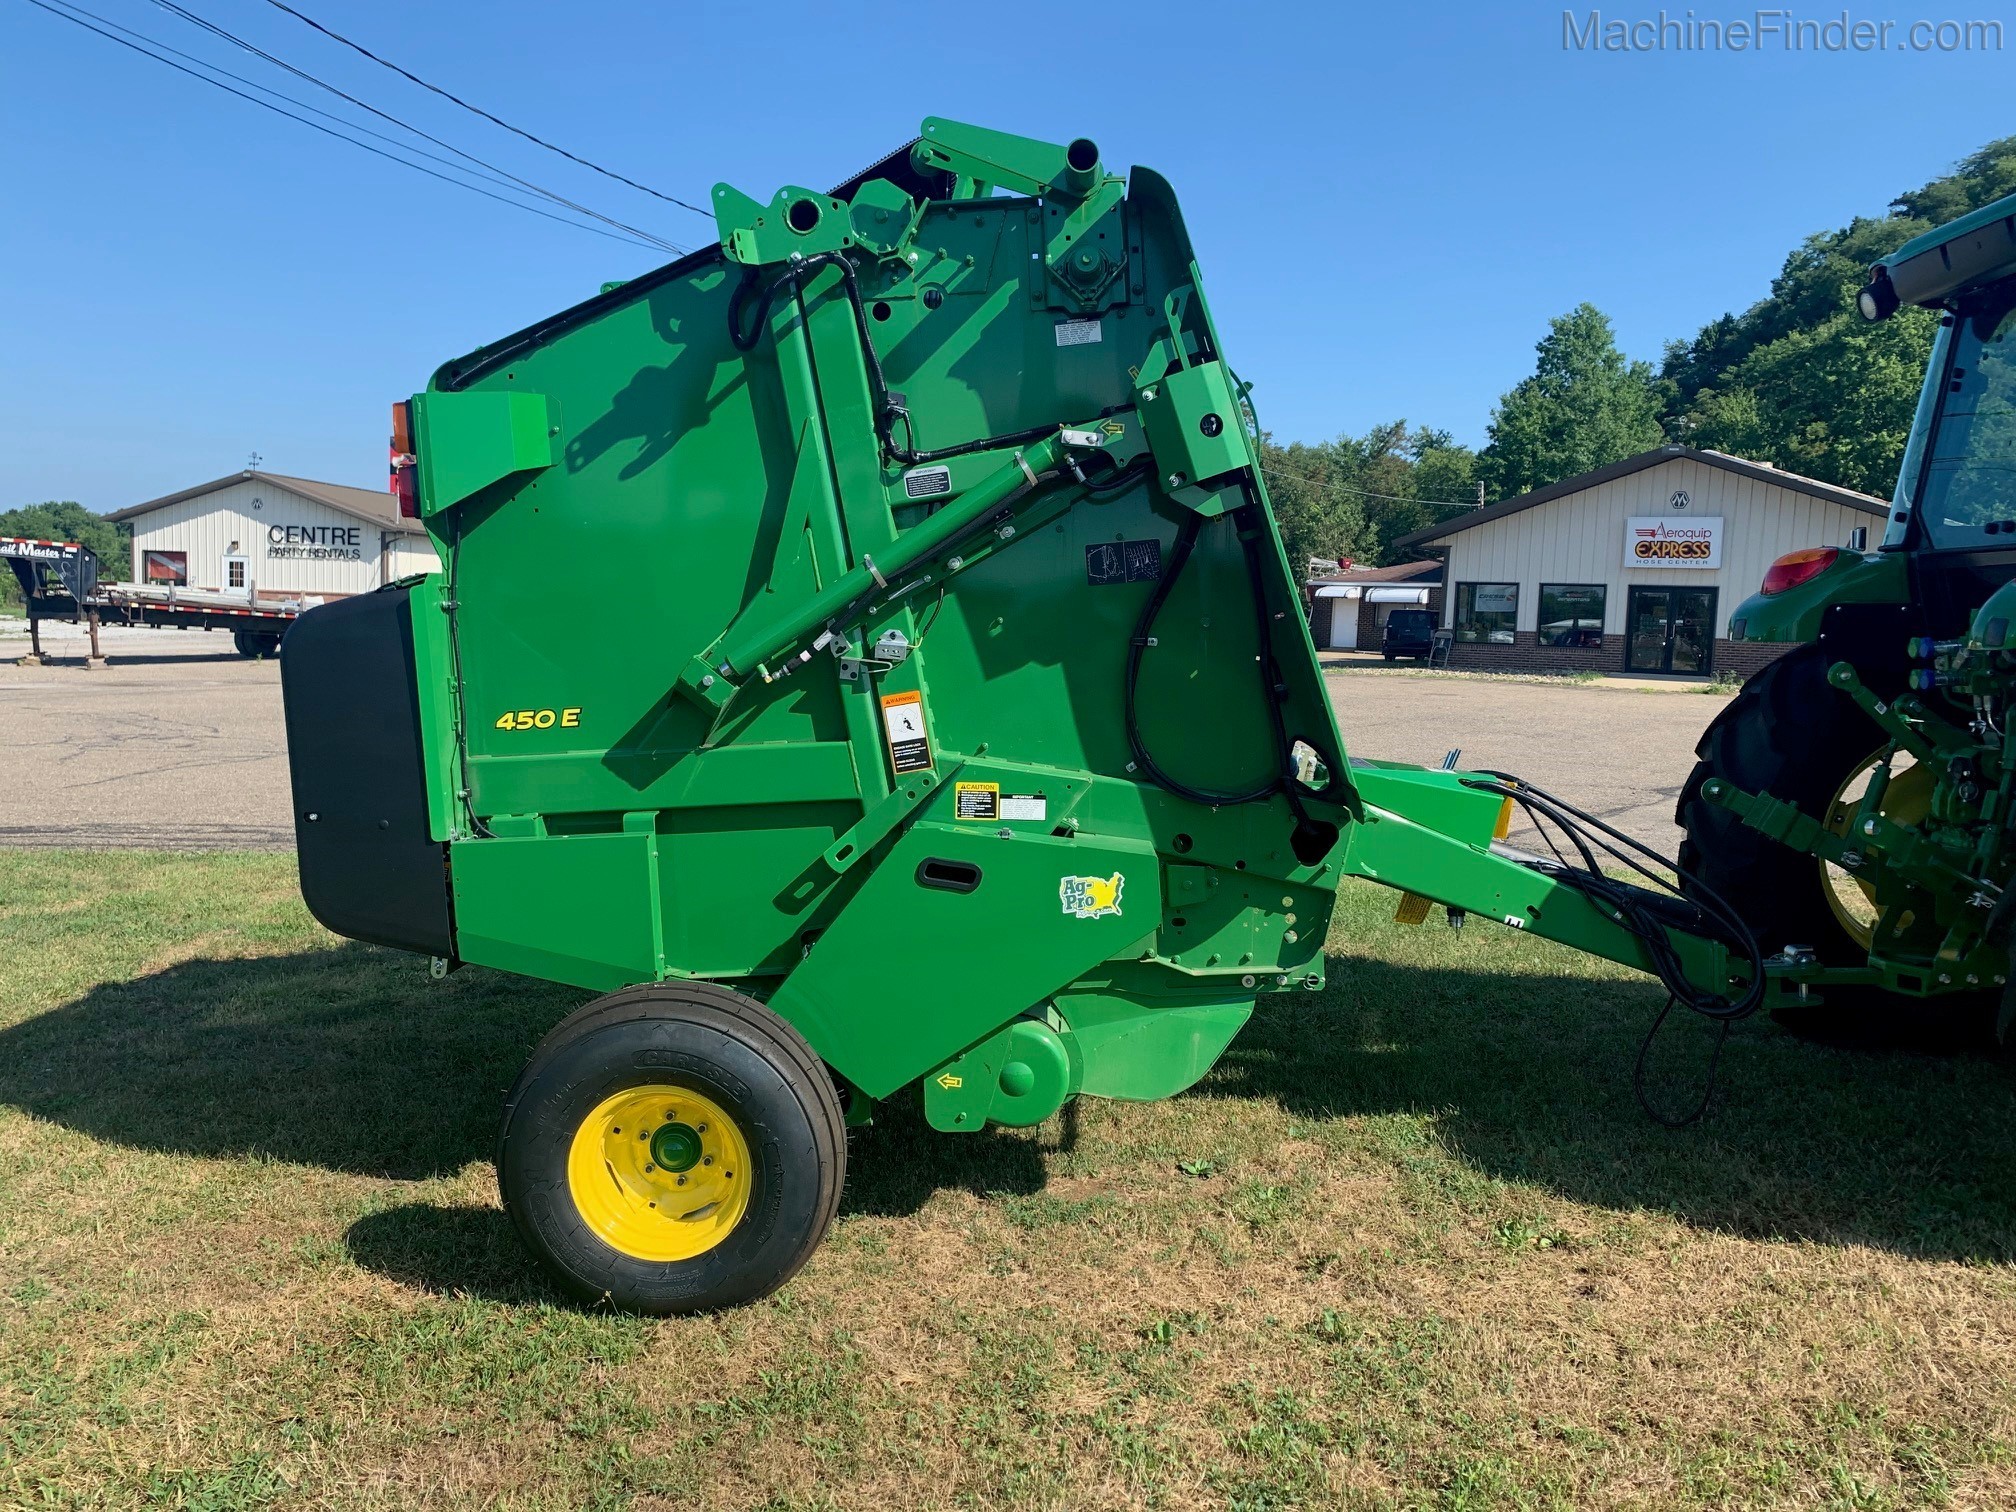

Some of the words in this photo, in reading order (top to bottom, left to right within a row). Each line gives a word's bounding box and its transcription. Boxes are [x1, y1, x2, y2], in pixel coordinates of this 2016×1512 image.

[269, 525, 361, 546] CENTRE
[1655, 521, 1712, 540] Aeroquip
[0, 543, 17, 555] ail
[18, 542, 60, 559] Master
[269, 547, 306, 558] PARTY
[308, 547, 361, 559] RENTALS
[1635, 541, 1711, 559] EXPRESS
[890, 695, 916, 703] WARNING
[495, 709, 557, 731] 450
[560, 707, 582, 728] E
[1064, 879, 1092, 896] Ag-
[1065, 895, 1095, 910] Pro
[643, 1050, 748, 1098] CARLISLE
